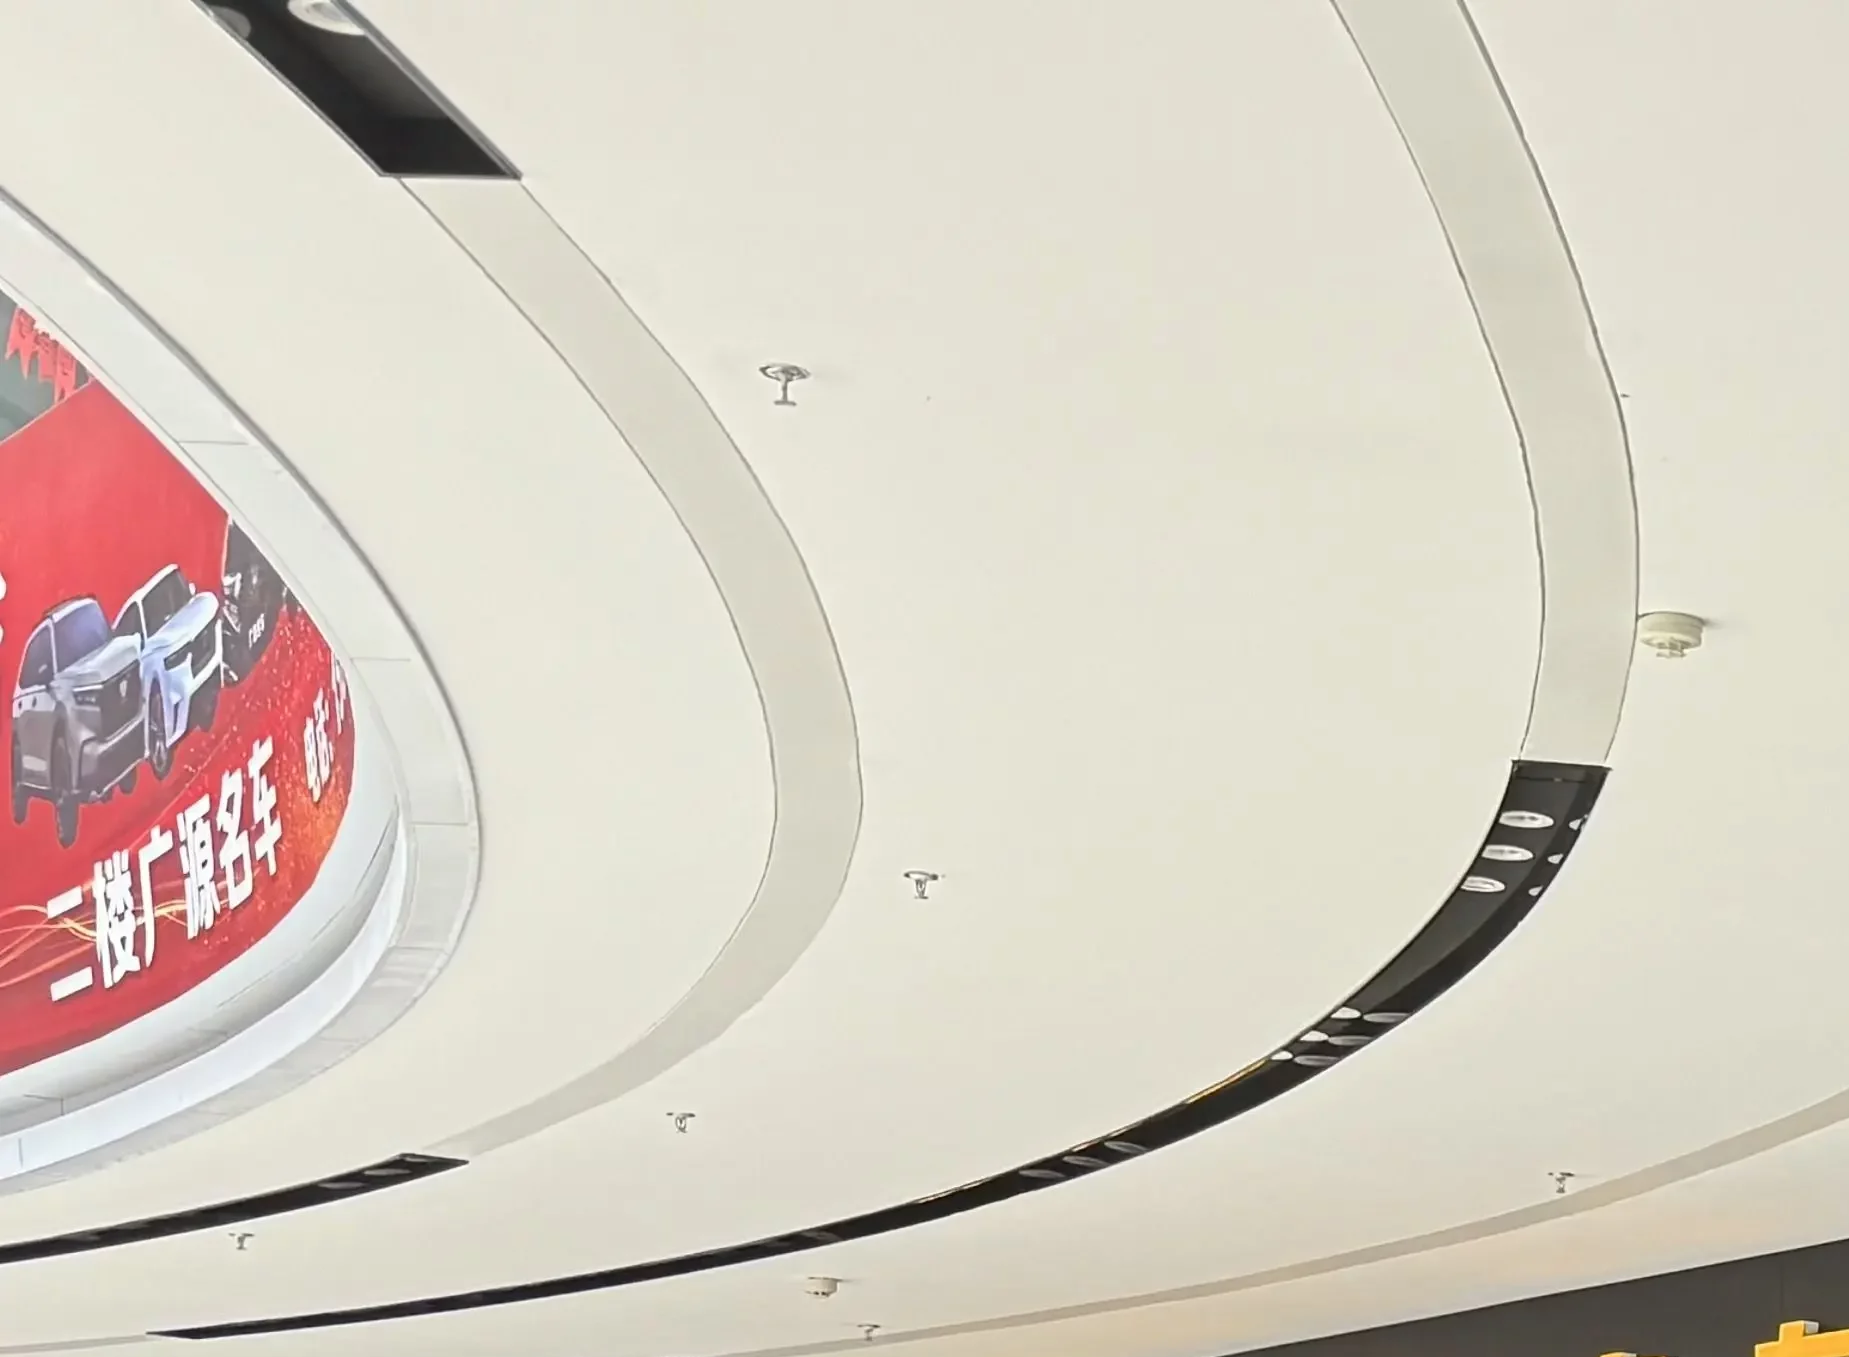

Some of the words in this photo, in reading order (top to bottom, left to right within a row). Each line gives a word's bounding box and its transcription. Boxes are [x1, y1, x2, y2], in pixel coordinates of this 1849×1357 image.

[46, 735, 283, 1002] 二楼广源名车
